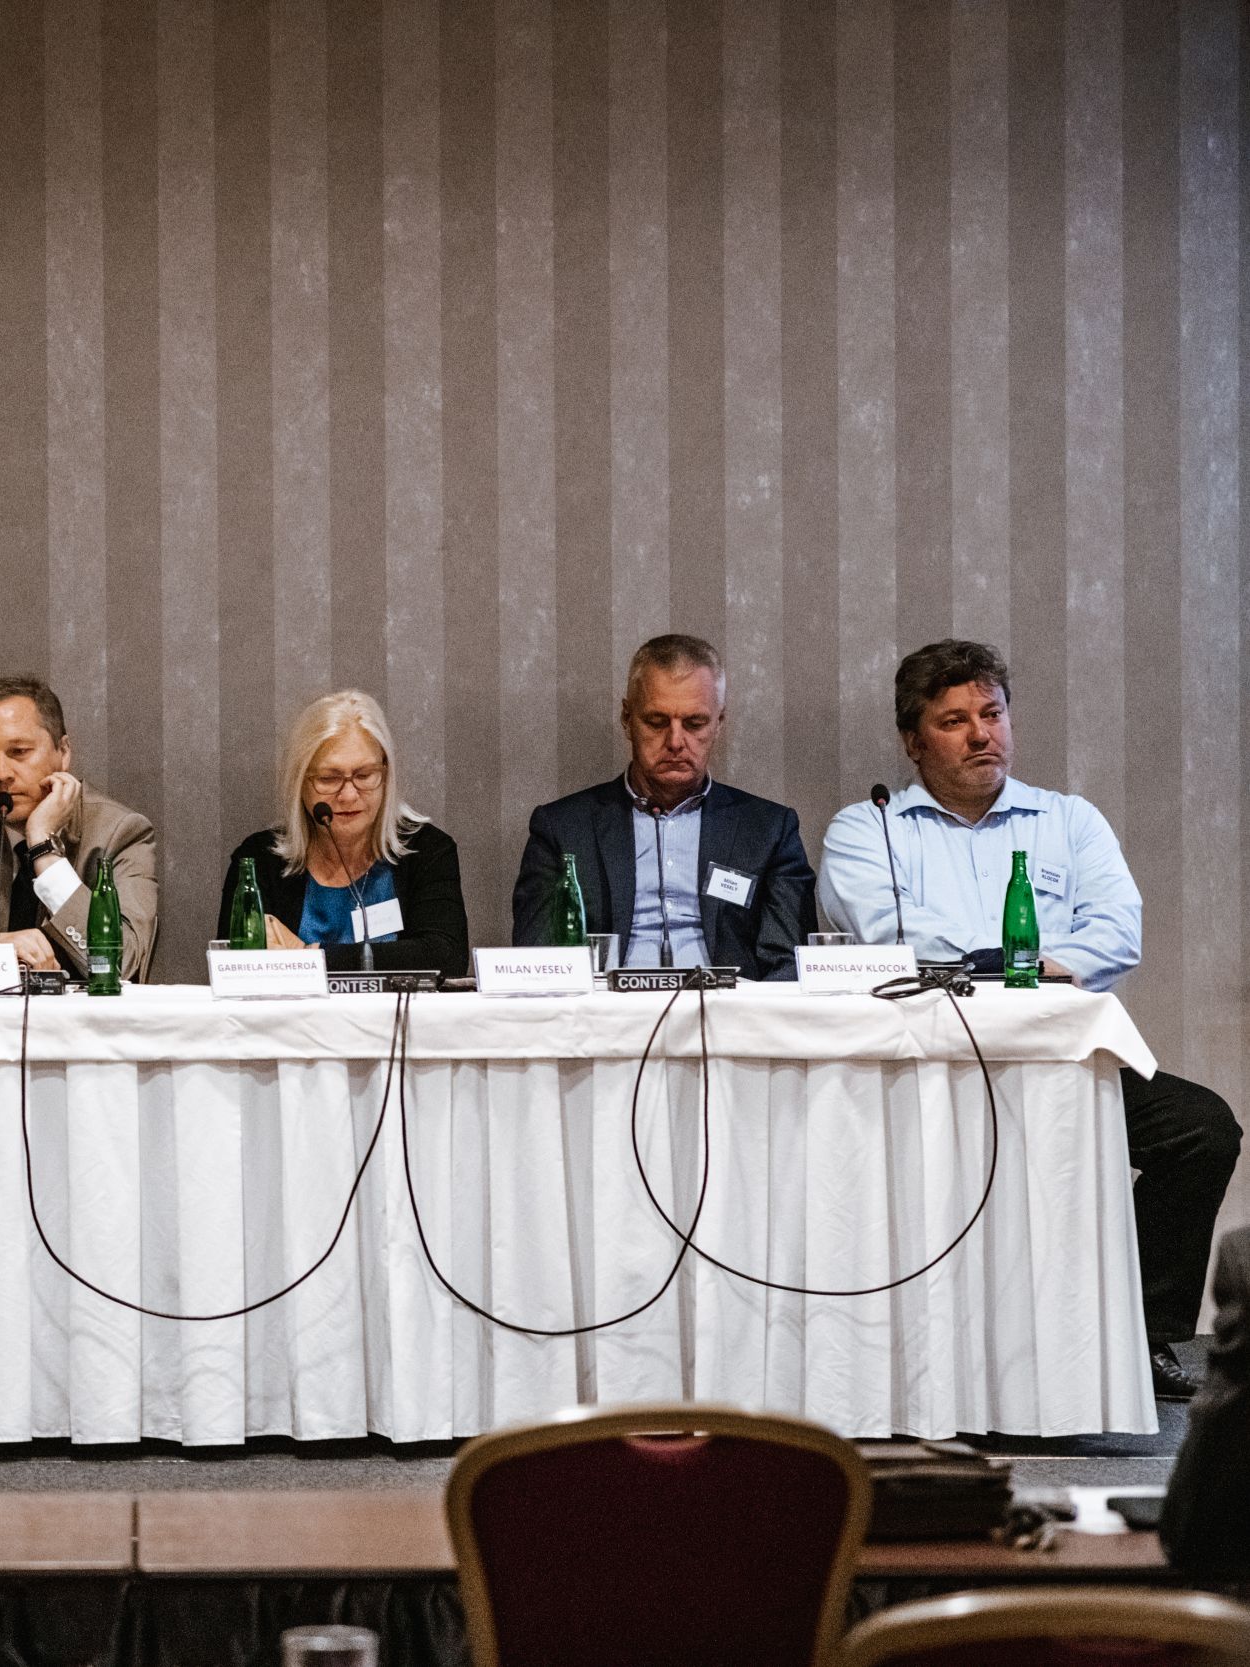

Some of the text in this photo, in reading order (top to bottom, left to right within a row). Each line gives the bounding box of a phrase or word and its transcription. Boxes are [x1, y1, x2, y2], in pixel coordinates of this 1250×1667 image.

[217, 963, 264, 972] GABRIELA
[494, 963, 573, 974] MILAN VESELÝ
[805, 963, 909, 973] BRANISLAV KLOCOK
[329, 977, 386, 993] ONTEST
[618, 973, 686, 989] CONTEST
